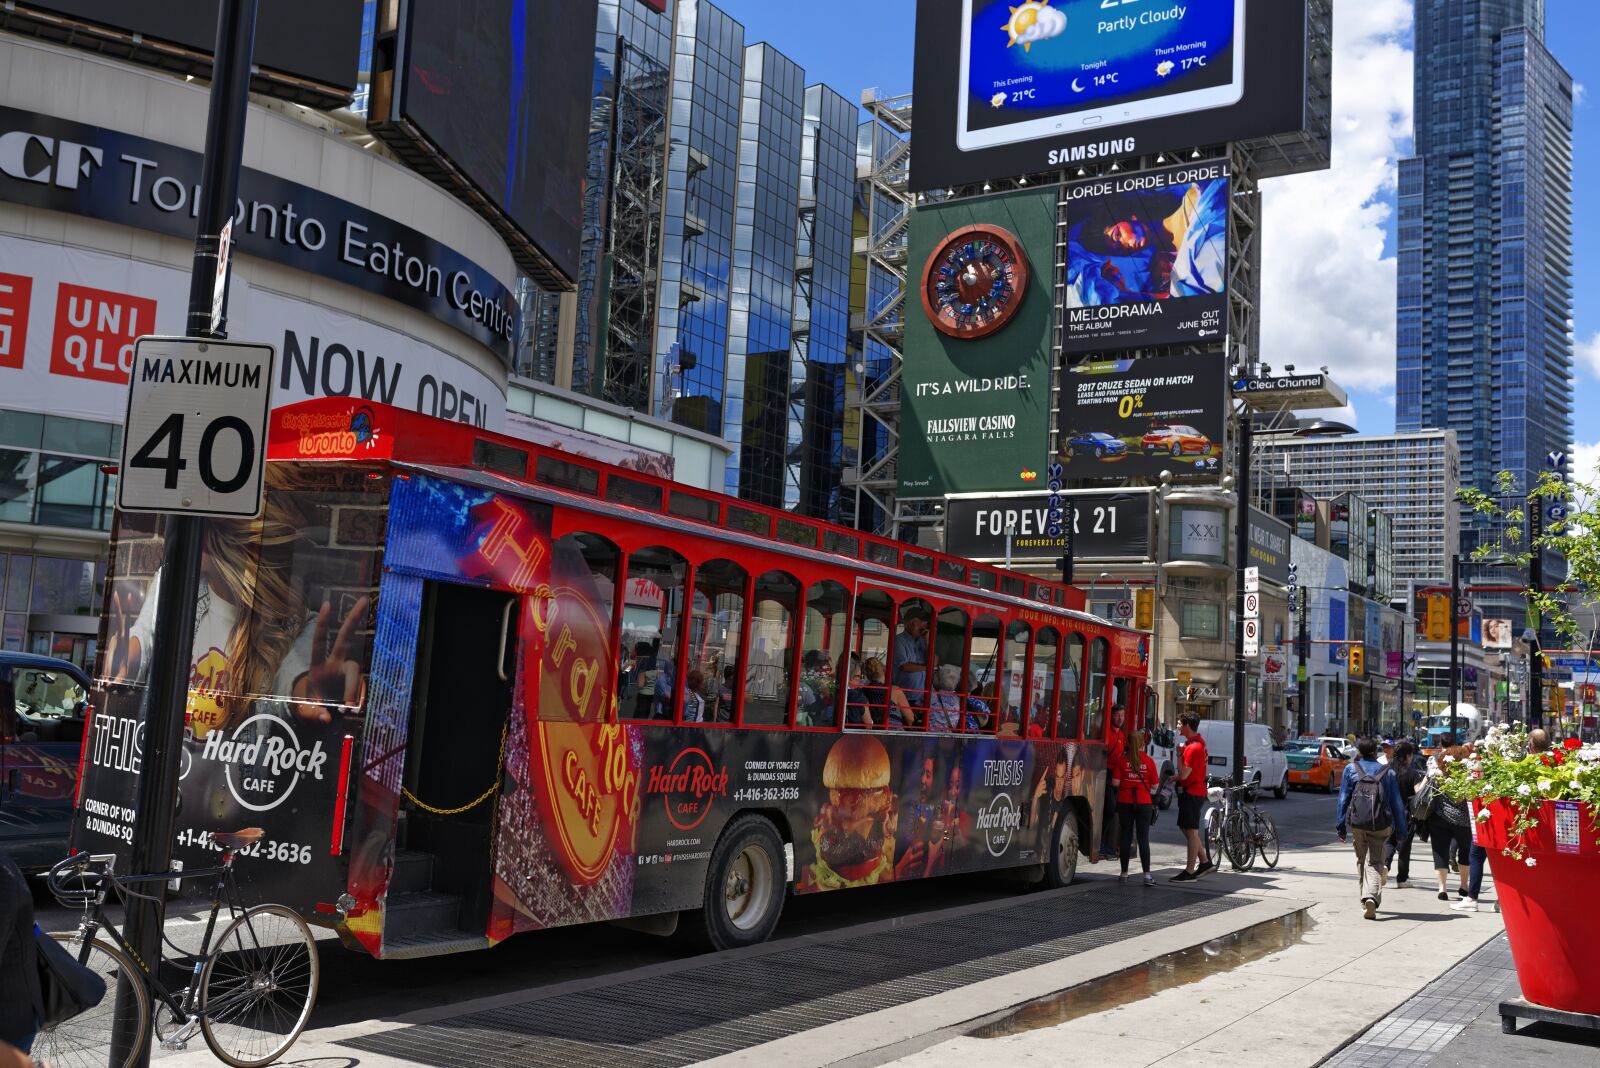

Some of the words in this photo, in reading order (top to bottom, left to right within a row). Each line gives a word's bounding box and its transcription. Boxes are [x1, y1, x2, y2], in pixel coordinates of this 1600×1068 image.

[1097, 16, 1136, 34] Partly
[1139, 4, 1187, 26] Cloudy
[1155, 45, 1176, 56] Thurs
[1176, 40, 1207, 53] Morning
[1081, 60, 1107, 71] Tonight
[1180, 55, 1207, 70] 17°C
[993, 80, 1006, 88] This
[1007, 75, 1033, 86] Evening
[1093, 73, 1119, 86] 14°C
[1048, 137, 1136, 165] SAMSUNG
[1066, 182, 1114, 200] LORDE
[1116, 175, 1165, 192] LORDE
[1168, 168, 1220, 185] LORDE
[0, 131, 103, 189] CF
[120, 154, 326, 251] Tornto
[343, 220, 442, 297] Eaton
[452, 270, 513, 340] Centre
[68, 296, 138, 337] UNI
[1070, 302, 1162, 322] MELODRAMA
[1202, 310, 1219, 319] OUT
[1069, 324, 1084, 332] THE
[1085, 321, 1112, 330] ALBUM
[1177, 320, 1199, 330] JUNE
[142, 358, 261, 389] MAXIMUM
[280, 329, 403, 404] NOW
[417, 374, 487, 429] OPEN
[916, 383, 940, 396] IT'S
[942, 381, 952, 394] A
[955, 378, 992, 393] WILD
[994, 375, 1031, 390] RIDE.
[1077, 383, 1096, 392] 2017
[1096, 381, 1123, 391] CRUZE
[1124, 378, 1151, 389] SEDAN
[1153, 377, 1164, 386] OR
[1165, 375, 1194, 385] HATCH
[1248, 380, 1275, 390] Clear
[1277, 376, 1321, 388] Channel
[1106, 388, 1129, 396] FINANCE
[1077, 397, 1102, 405] STARTING
[927, 417, 977, 434] FALLSVIEW
[978, 414, 1016, 431] CASINO
[299, 431, 357, 455] Toronto
[926, 434, 977, 443] NIAGARA
[982, 431, 1014, 439] FALLS
[130, 412, 255, 493] 40
[975, 507, 1080, 536] FOREVR
[1093, 506, 1116, 534] 21
[1189, 524, 1219, 539] XXI
[1016, 538, 1065, 547] FOREVER21.CO
[191, 709, 216, 725] CAFE
[202, 729, 264, 765] Hard
[263, 736, 327, 780] Rock
[744, 761, 767, 769] CORNER
[768, 761, 775, 769] OF
[776, 761, 794, 769] YONGE
[794, 761, 800, 769] ST
[984, 760, 1012, 786] THIS
[1012, 760, 1024, 786] IS
[243, 777, 275, 793] CAFE
[648, 765, 691, 794] Hard
[691, 765, 729, 798] Rock
[753, 773, 776, 781] DUNDAS
[776, 773, 797, 782] SQUARE
[565, 751, 601, 835] CAFE
[734, 787, 799, 801] +1-416-362-3636
[85, 798, 109, 816] CORNER
[110, 805, 120, 819] OF
[121, 807, 136, 823] YON
[676, 802, 699, 814] CAFE
[86, 815, 91, 829] &
[92, 818, 120, 838] DUNDAS
[976, 806, 1002, 830] Hard
[1001, 805, 1021, 832] Rock
[667, 838, 701, 847] HARDROCK.COM
[992, 835, 1005, 844] CAFE
